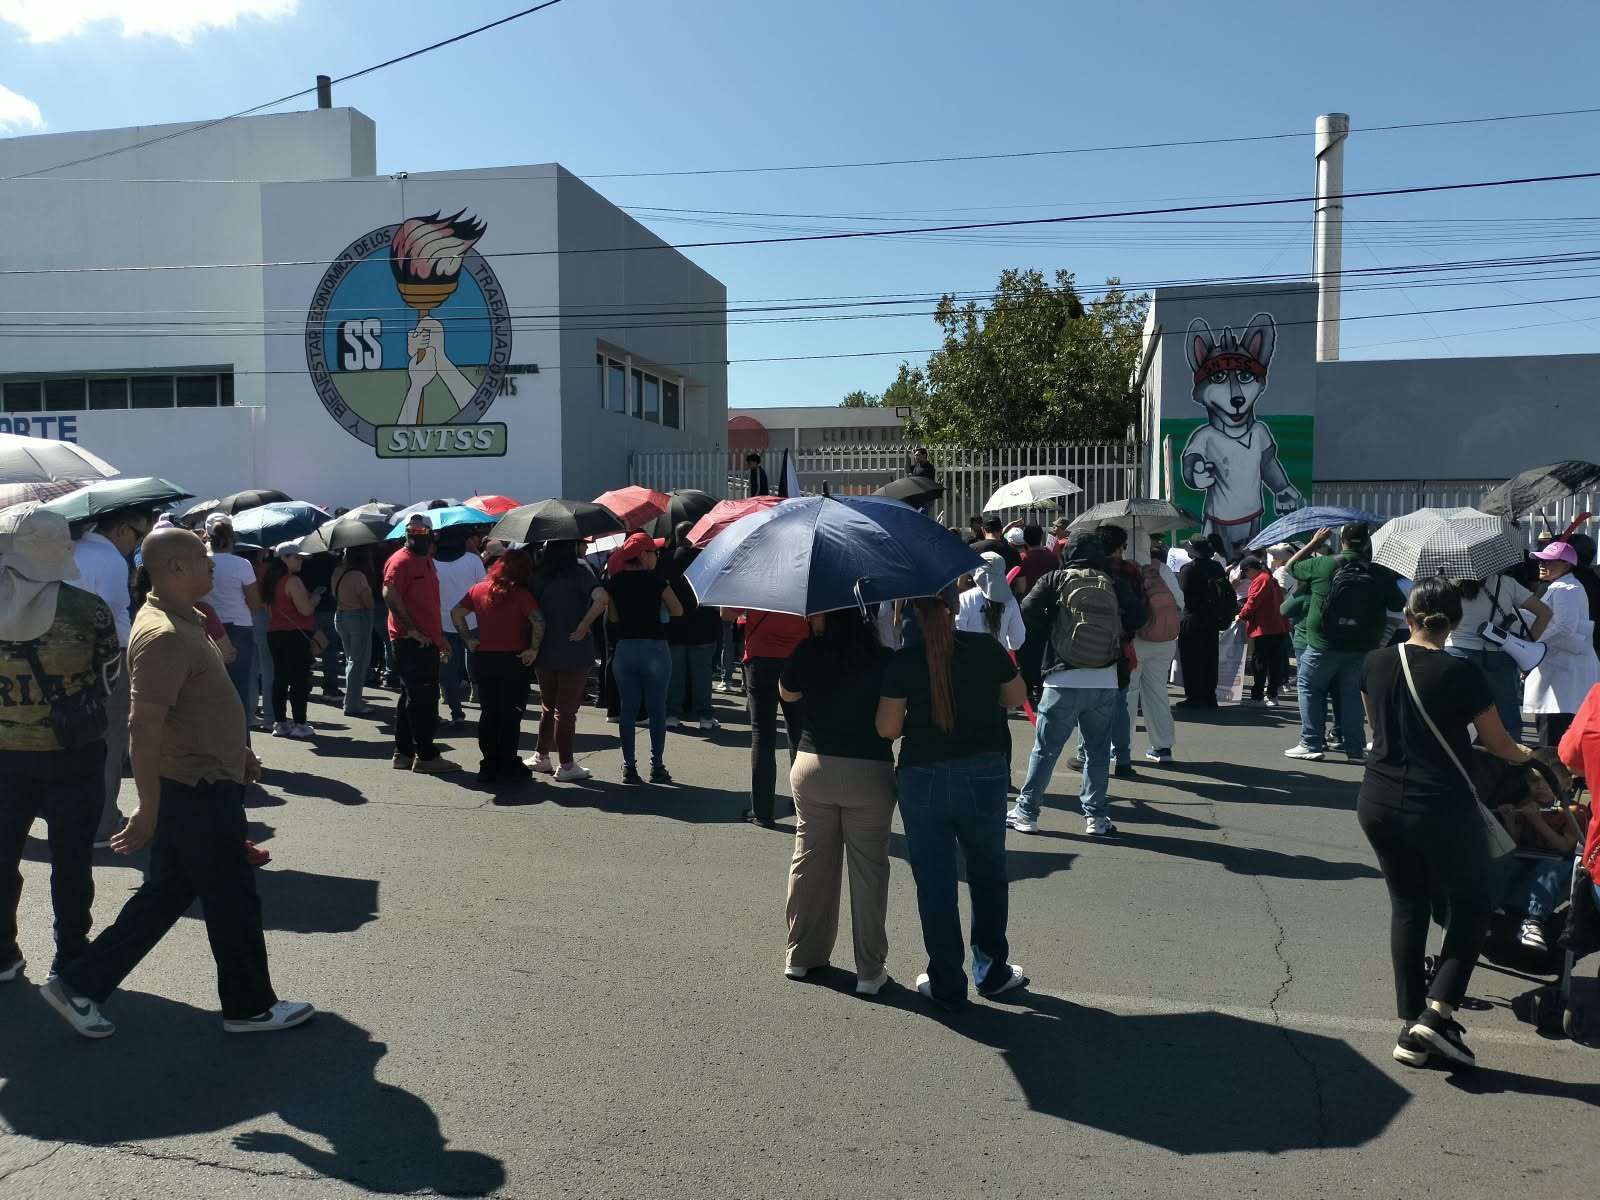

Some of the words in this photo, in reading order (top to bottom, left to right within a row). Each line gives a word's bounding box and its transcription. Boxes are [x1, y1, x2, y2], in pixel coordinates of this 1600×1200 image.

[311, 253, 353, 321] ECONOMICO
[338, 319, 382, 370] SS
[474, 264, 508, 410] TRABAJADORES
[309, 330, 347, 418] BIENESTAR
[349, 421, 360, 434] Y
[388, 428, 495, 451] SNTSS
